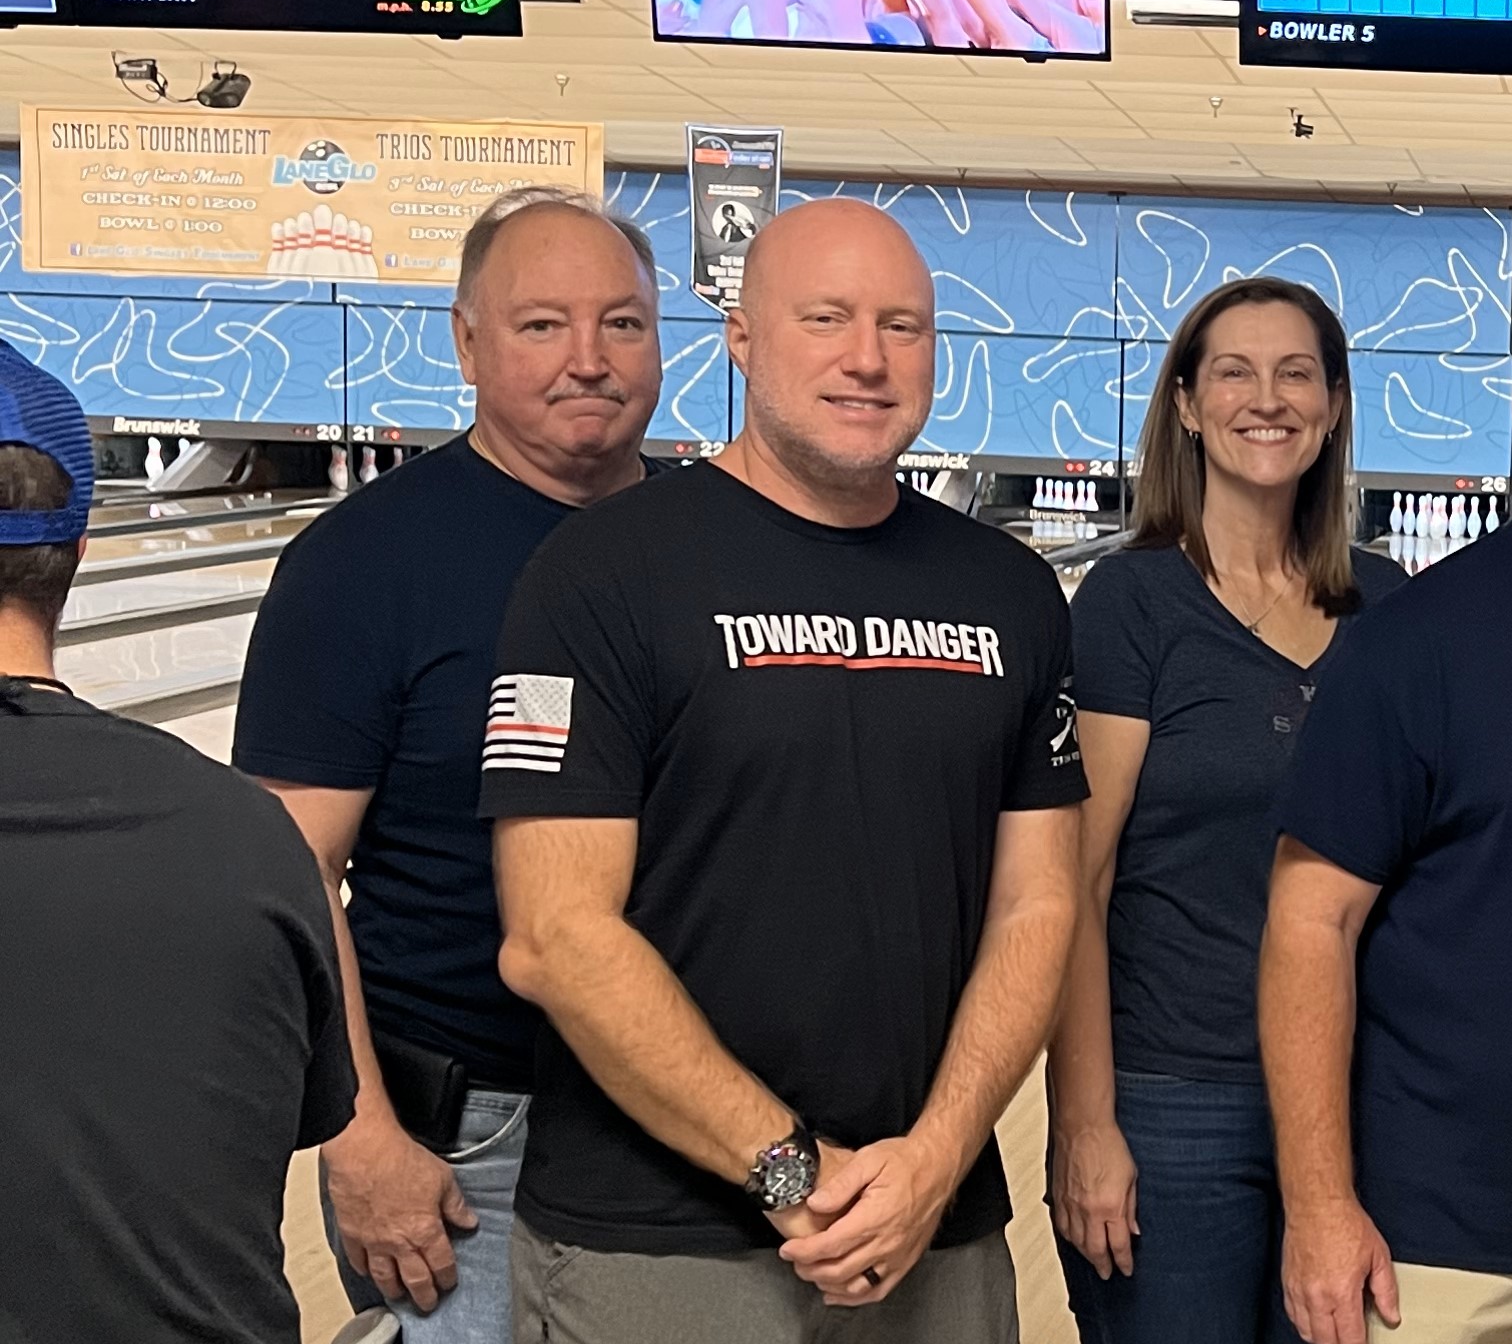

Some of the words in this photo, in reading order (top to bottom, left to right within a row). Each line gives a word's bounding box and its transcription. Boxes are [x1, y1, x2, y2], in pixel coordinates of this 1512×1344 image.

[1270, 21, 1356, 43] BOWLER
[1361, 26, 1376, 43] 5
[52, 123, 129, 150] SINGLES
[136, 125, 271, 155] TOURNAMENT
[376, 134, 431, 160] TRIOS
[441, 136, 575, 166] TOURNAMENT
[102, 165, 126, 181] Sat
[132, 167, 151, 186] of
[153, 167, 188, 184] Each
[192, 167, 244, 186] Month
[450, 178, 468, 197] of
[82, 192, 181, 207] CHECK-IN
[203, 196, 257, 210] 12:00
[100, 217, 159, 230] BOWL
[113, 416, 200, 435] Brunswick
[316, 424, 341, 440] 20
[353, 425, 375, 441] 21
[1089, 460, 1115, 476] 24
[1481, 477, 1506, 492] 26
[714, 614, 858, 669] TOWARD
[864, 617, 1004, 677] DANGER
